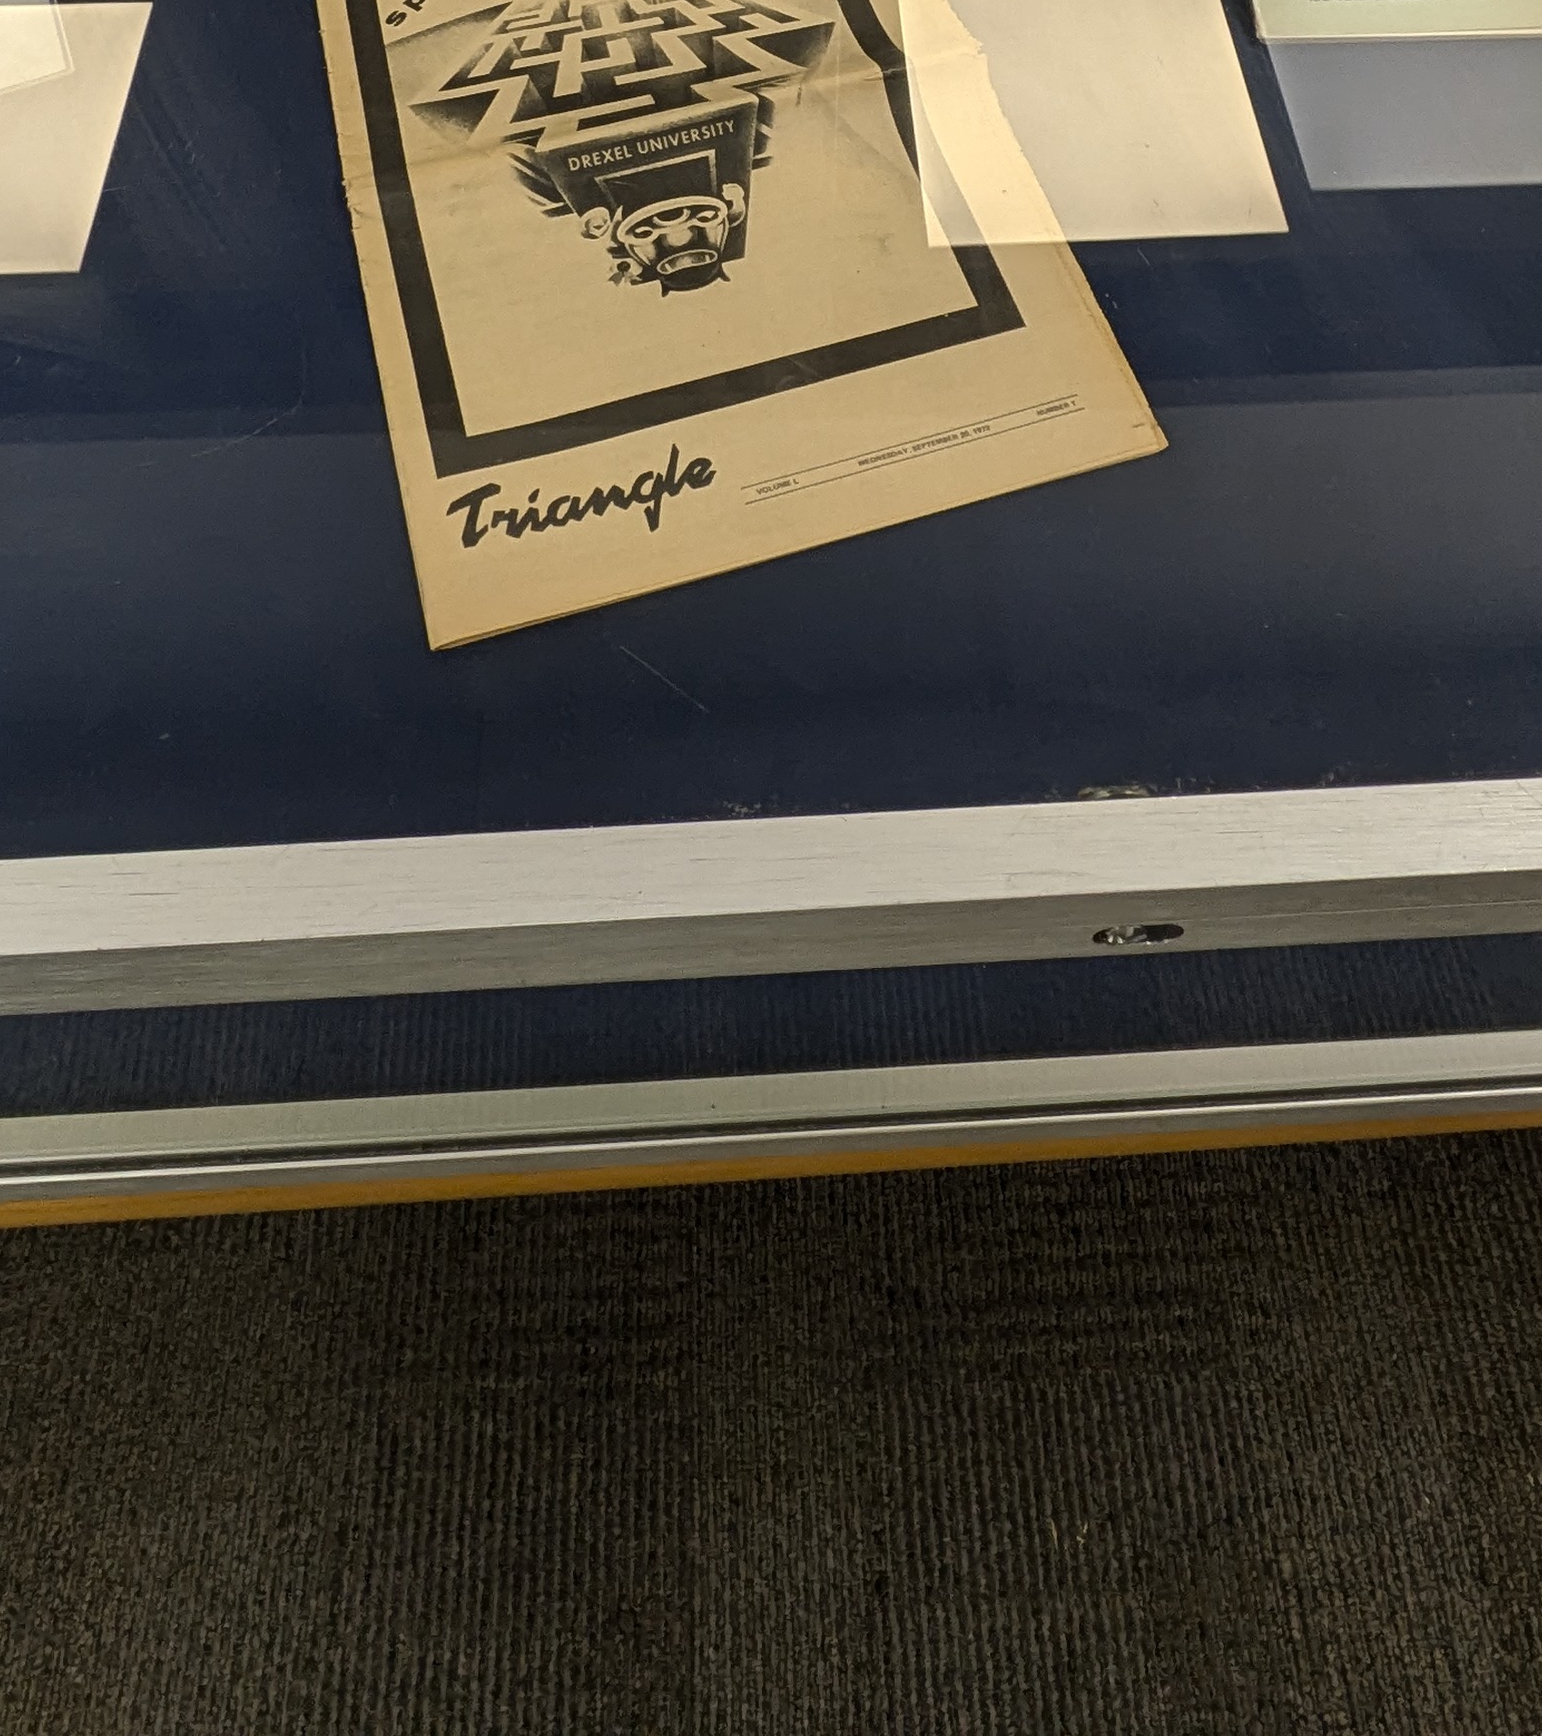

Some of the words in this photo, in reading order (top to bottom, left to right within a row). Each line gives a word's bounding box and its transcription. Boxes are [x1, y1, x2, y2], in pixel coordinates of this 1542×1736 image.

[568, 145, 632, 171] DREXEL
[636, 120, 735, 155] UNIVERSITY
[756, 479, 792, 495] VOLUME
[912, 433, 959, 453] SEPTEMBER
[446, 443, 719, 549] Triangle
